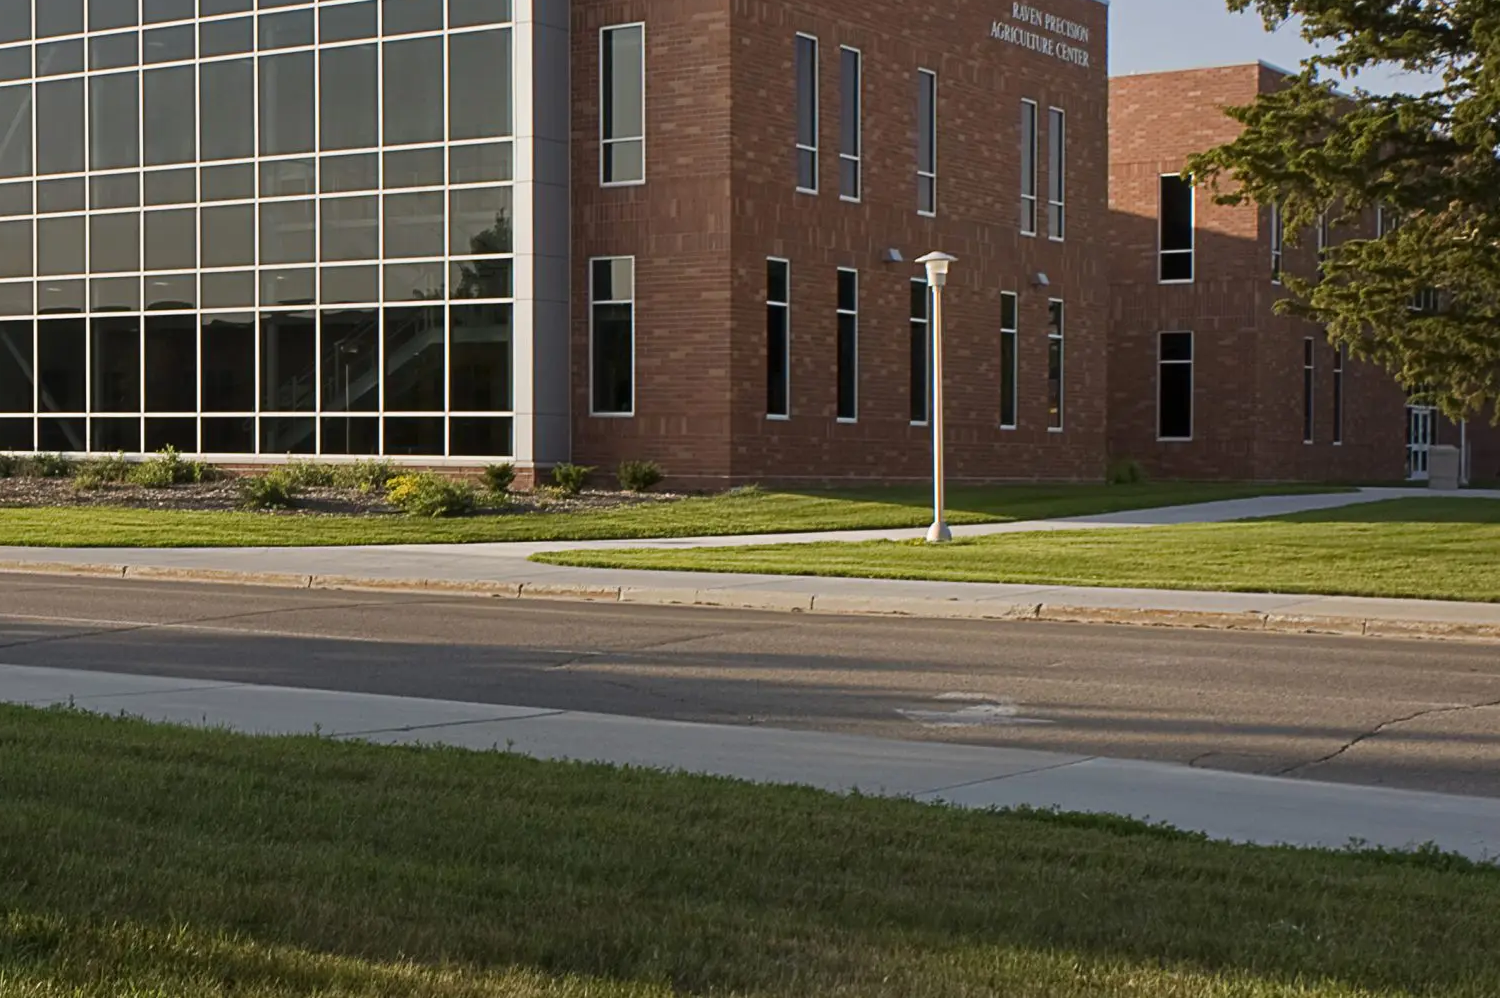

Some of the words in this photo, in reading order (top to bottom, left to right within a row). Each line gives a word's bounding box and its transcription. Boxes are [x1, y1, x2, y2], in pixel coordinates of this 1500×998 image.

[1012, 2, 1042, 26] RAVEN
[1044, 13, 1088, 42] PRECISION
[990, 21, 1054, 56] AGRICULTURE
[1055, 42, 1089, 67] CENTER
